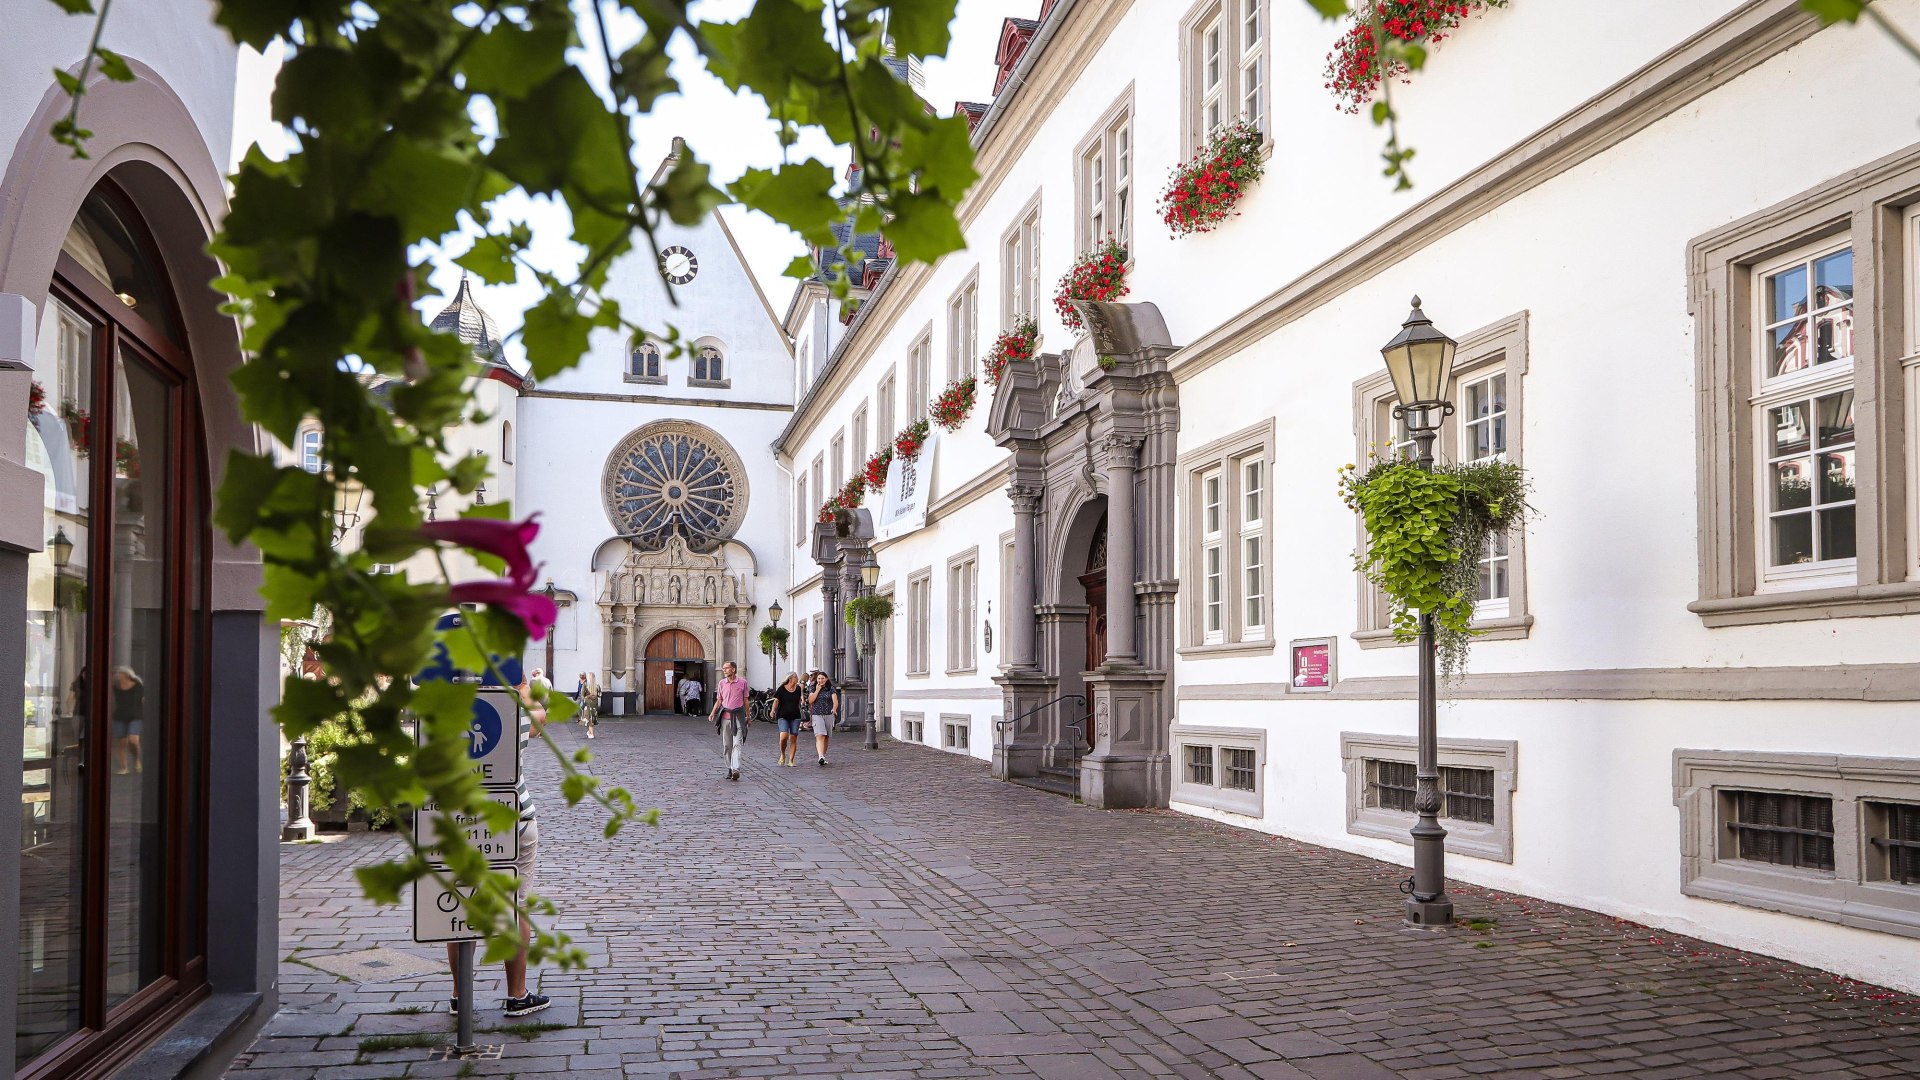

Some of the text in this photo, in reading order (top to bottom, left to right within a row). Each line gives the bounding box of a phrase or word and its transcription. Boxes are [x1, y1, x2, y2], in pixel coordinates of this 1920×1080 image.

[455, 814, 478, 825] frei
[465, 829, 492, 840] 11 h
[477, 843, 504, 854] 19 h
[450, 917, 476, 931] fre
